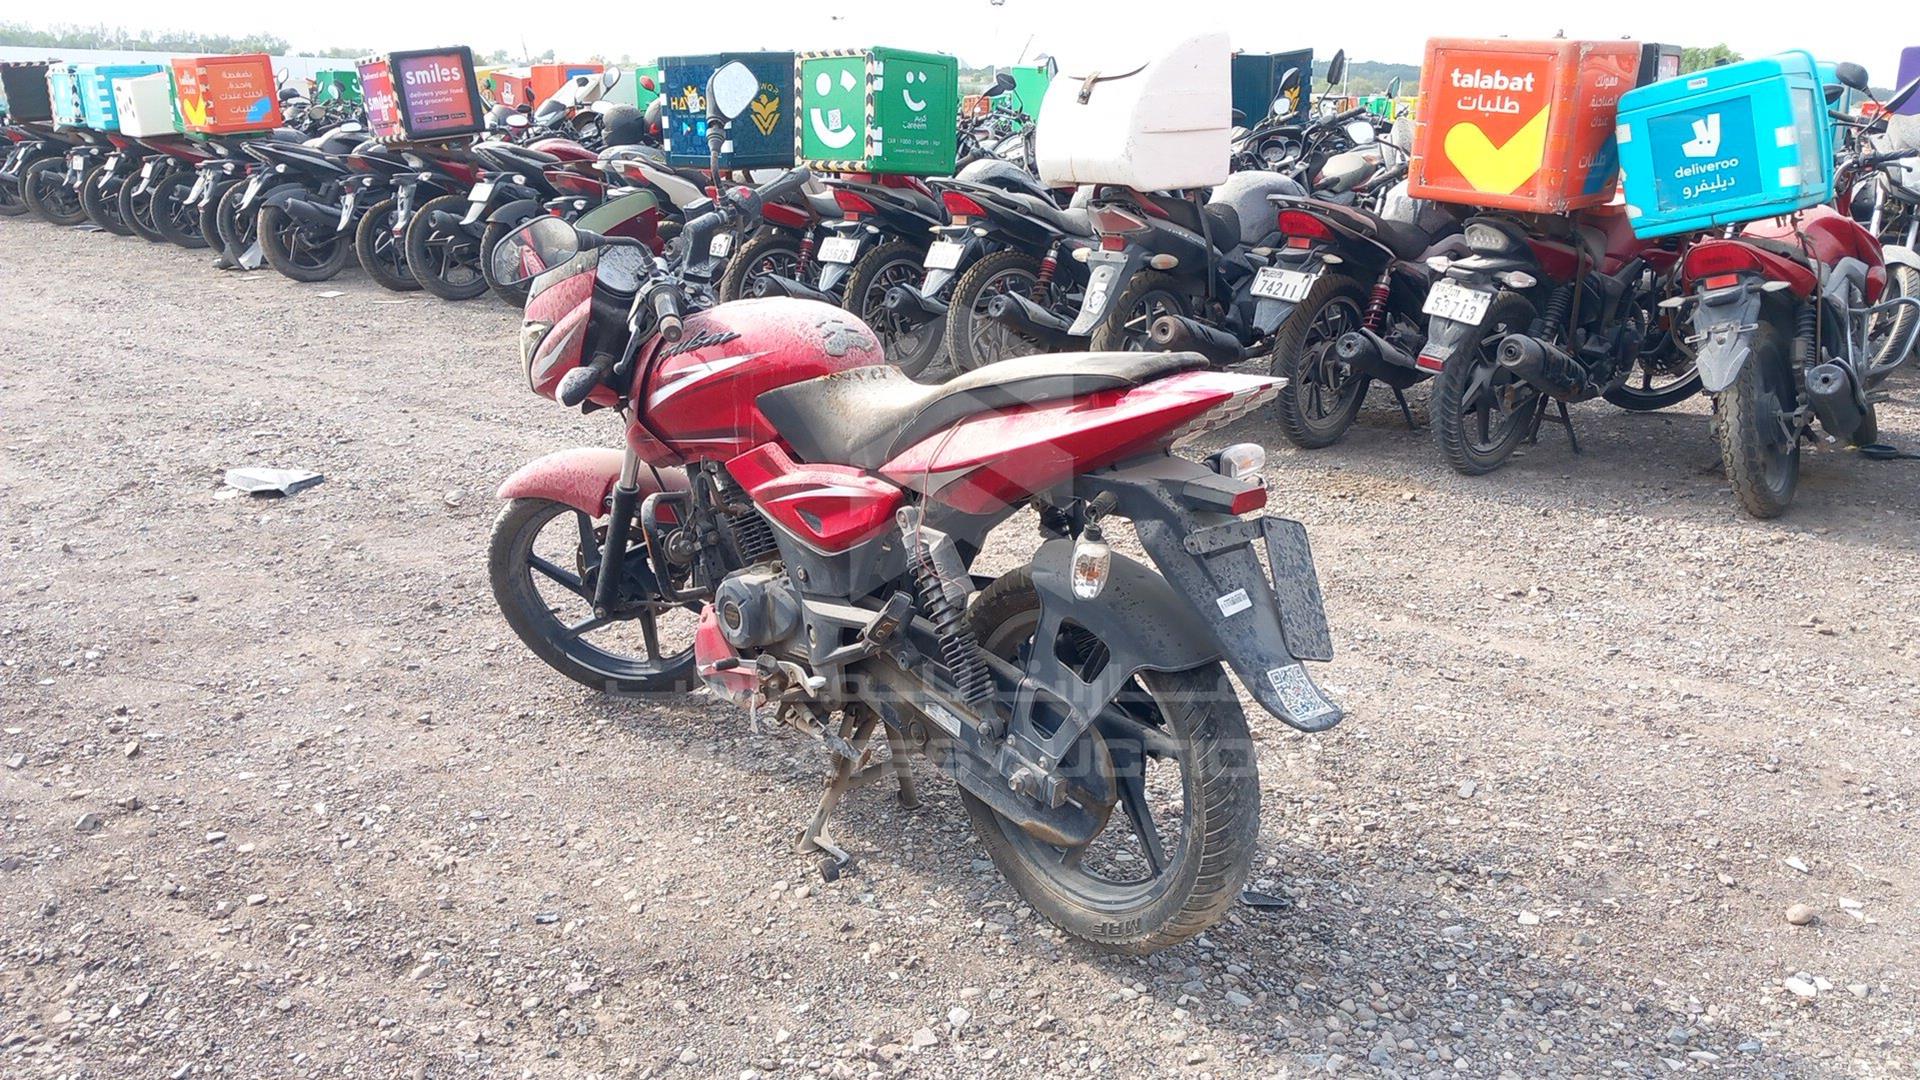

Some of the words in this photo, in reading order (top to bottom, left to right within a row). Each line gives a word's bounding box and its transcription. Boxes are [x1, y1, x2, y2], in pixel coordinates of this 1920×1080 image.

[405, 63, 461, 85] smiles
[1451, 67, 1535, 93] talabat
[1457, 93, 1520, 116] طلبات
[1674, 158, 1739, 178] deliveroo
[1682, 174, 1736, 200] ديليفرو
[1259, 279, 1298, 299] 74211
[1092, 918, 1142, 937] MRF
